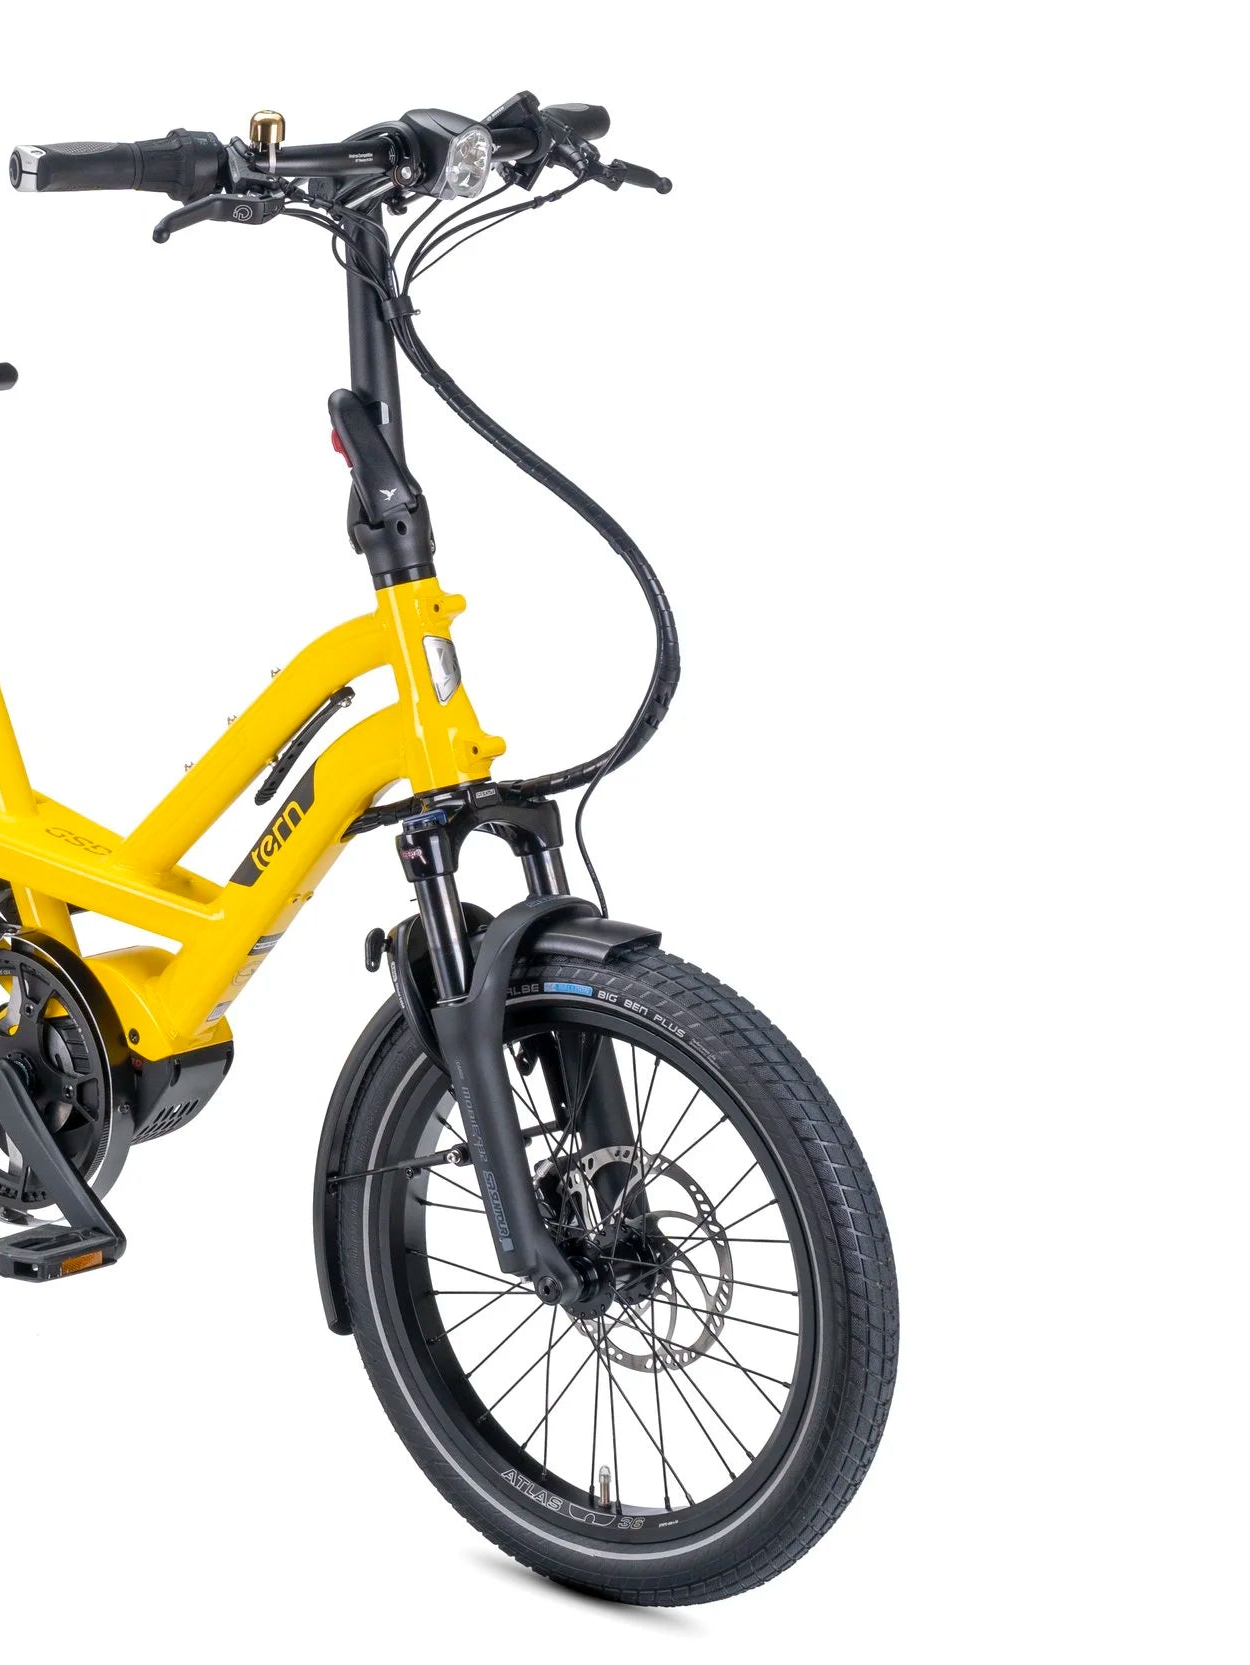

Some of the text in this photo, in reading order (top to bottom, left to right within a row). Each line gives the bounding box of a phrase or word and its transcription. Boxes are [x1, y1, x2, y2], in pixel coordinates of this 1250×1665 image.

[250, 800, 304, 871] tern
[506, 983, 540, 996] ALBE
[597, 990, 686, 1039] BIG BEN PLUS
[500, 1468, 646, 1530] ATLAS 36
